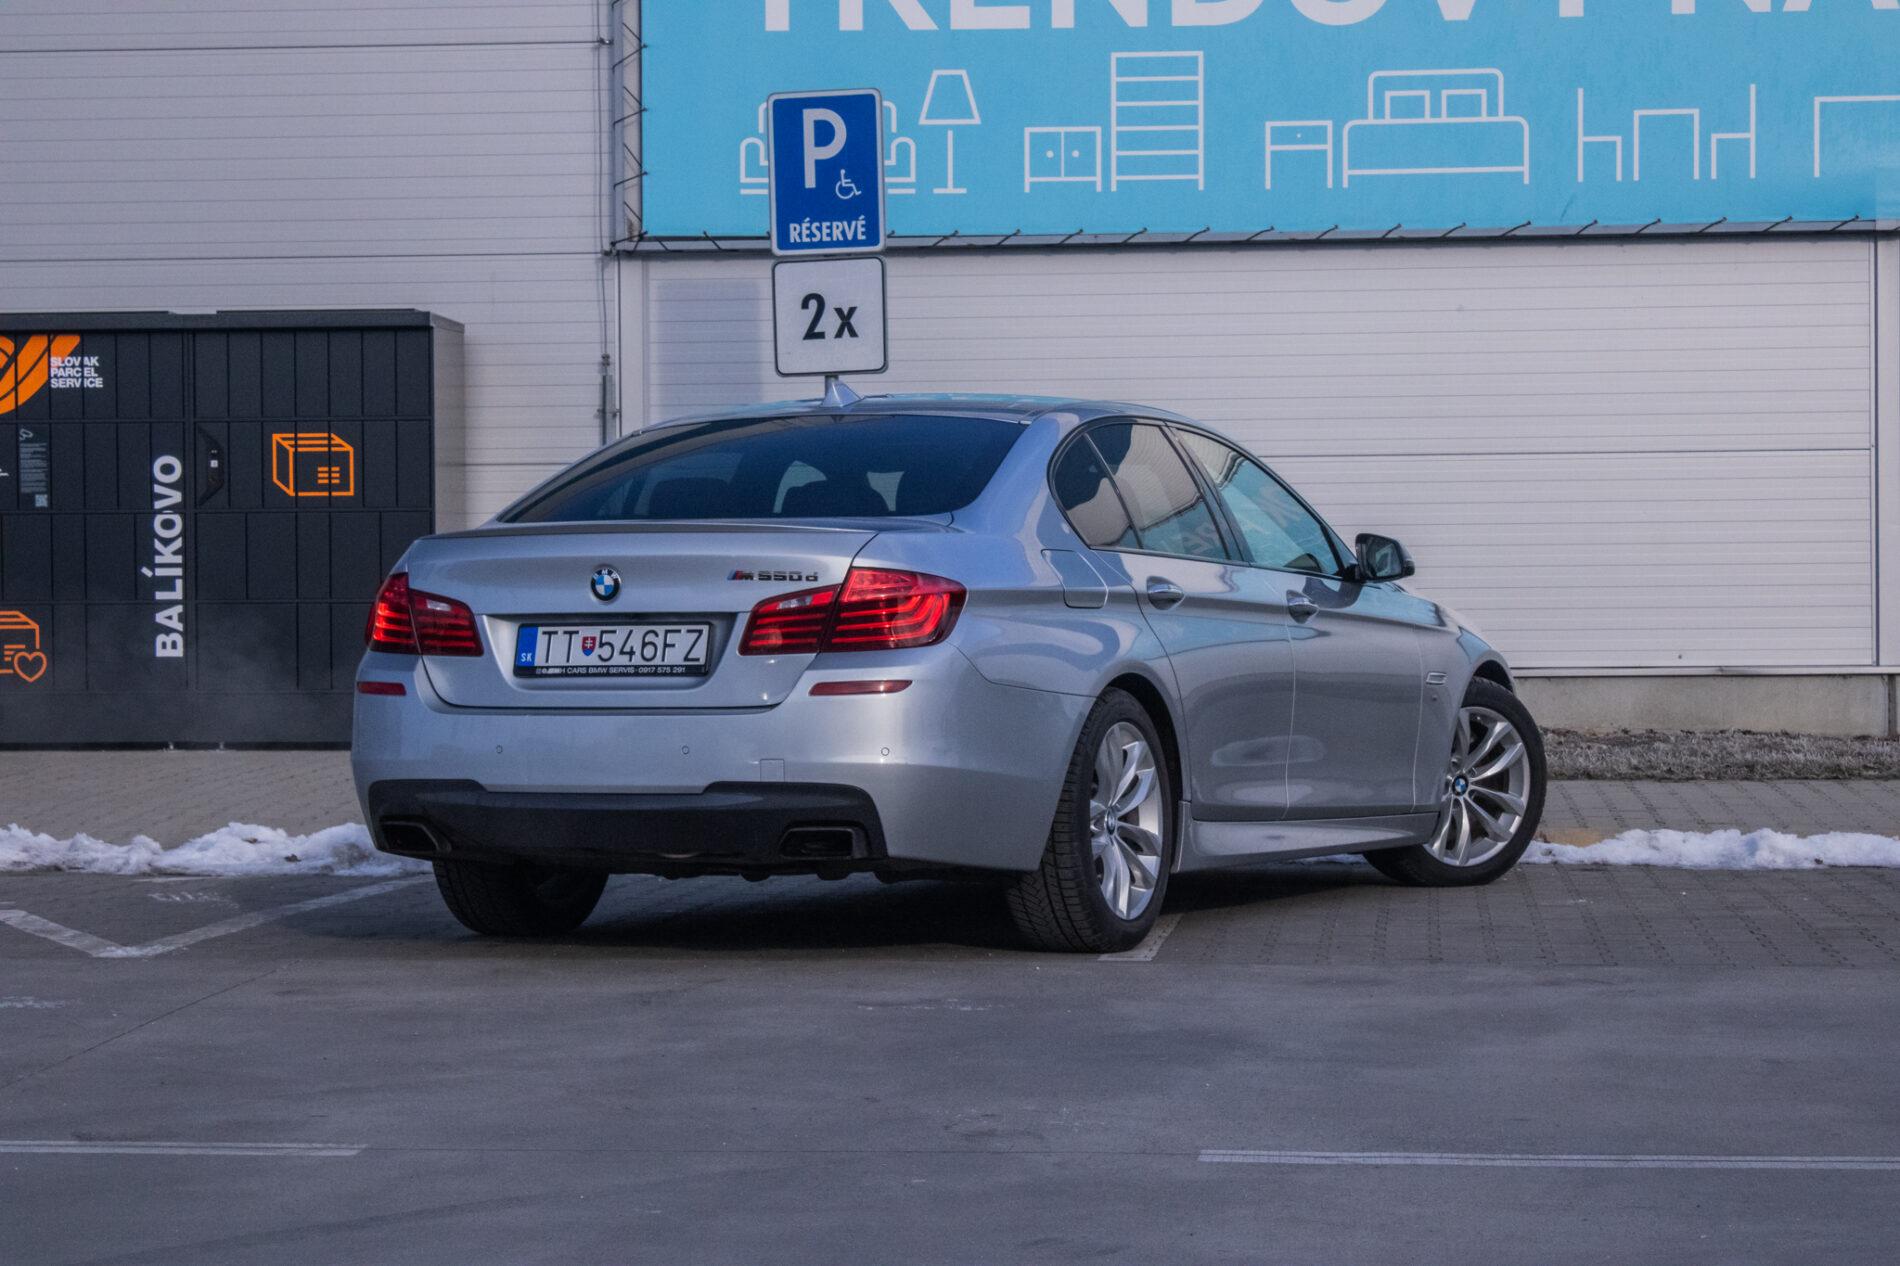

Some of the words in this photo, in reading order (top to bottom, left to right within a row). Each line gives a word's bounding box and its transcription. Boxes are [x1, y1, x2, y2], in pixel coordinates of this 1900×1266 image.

[803, 108, 847, 188] P
[789, 215, 867, 243] RÉSERVÉ
[50, 356, 99, 367] SLOVAK
[50, 367, 98, 378] PARCEL
[50, 377, 103, 388] SERVICE
[141, 455, 184, 658] BALÍKOVO
[520, 652, 532, 663] SK
